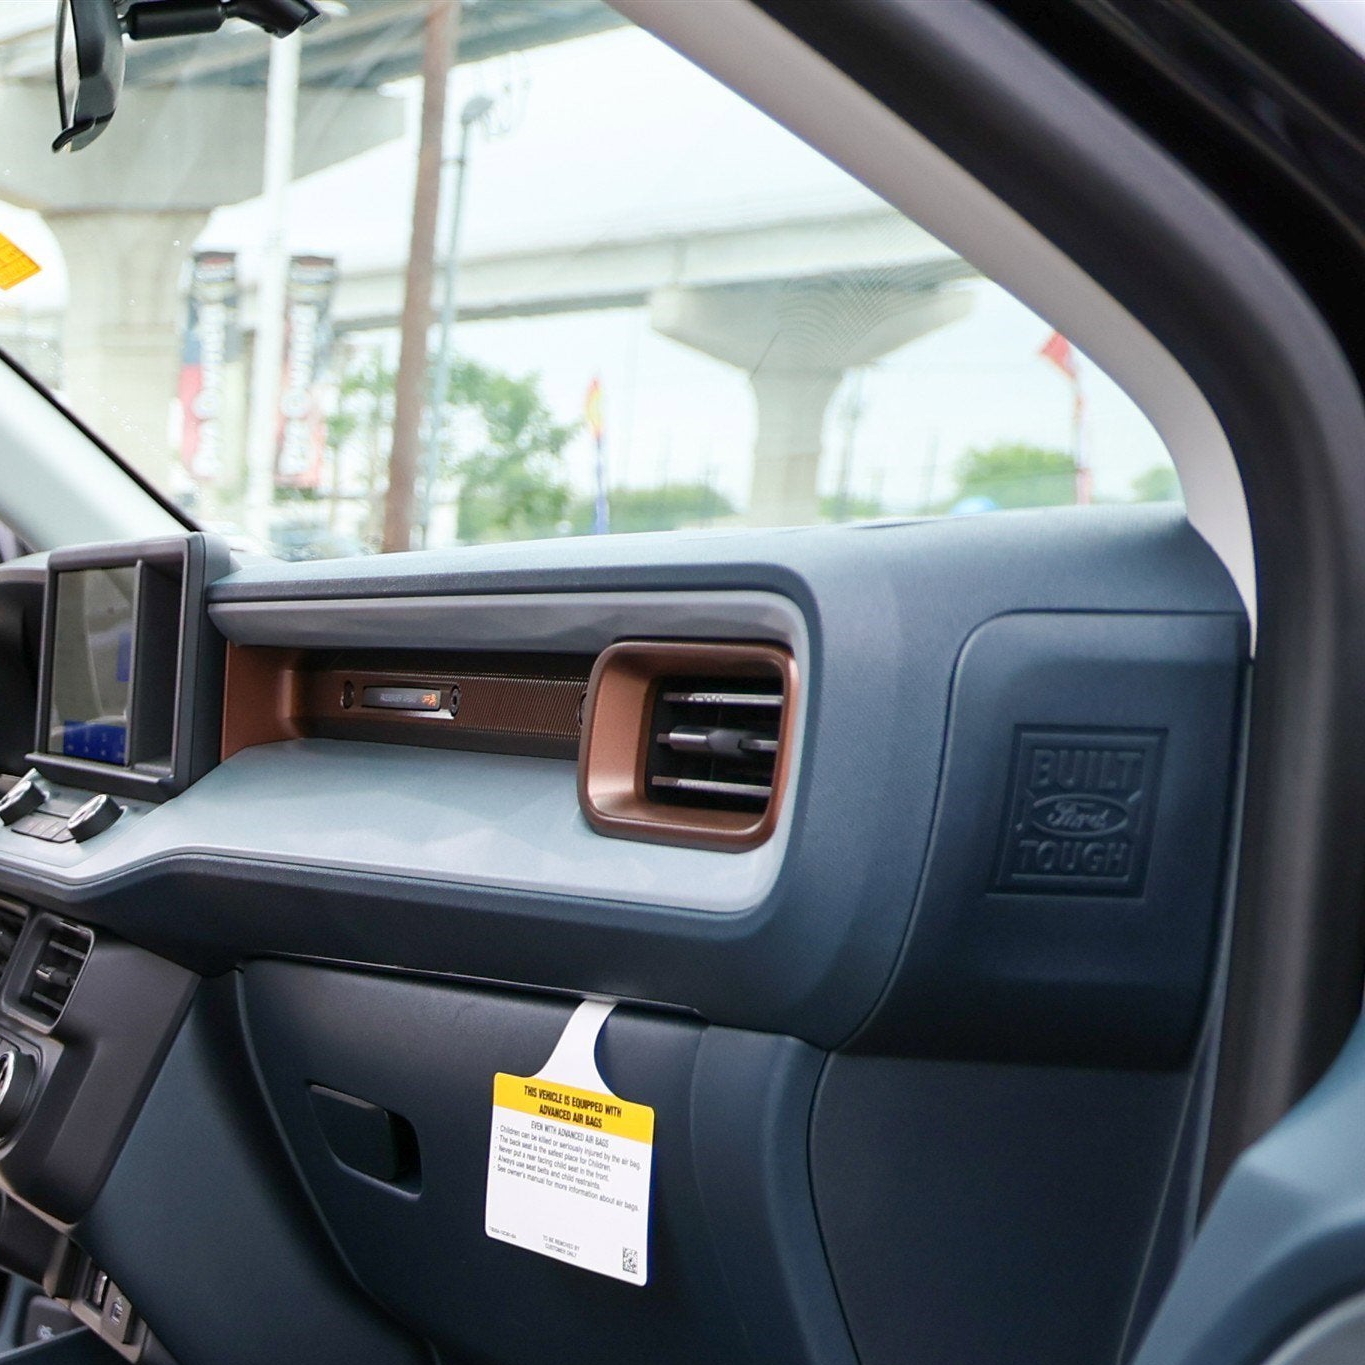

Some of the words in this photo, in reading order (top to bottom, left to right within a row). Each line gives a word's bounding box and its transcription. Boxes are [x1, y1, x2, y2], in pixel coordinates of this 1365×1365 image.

[1031, 748, 1142, 789] BUILT
[1046, 802, 1110, 829] Ford
[1018, 840, 1128, 872] TOUGH
[524, 1085, 537, 1097] THIS
[539, 1089, 562, 1103] VEHICLE
[564, 1095, 570, 1105] IS
[572, 1097, 603, 1114] EQUIPPED
[605, 1105, 621, 1117] WITH
[539, 1104, 571, 1121] ADVANCED
[573, 1113, 583, 1124] AIR
[585, 1116, 602, 1129] BAGS
[500, 1125, 520, 1136] Children
[558, 1128, 583, 1141] ADVANCED
[595, 1137, 609, 1148] BAGS
